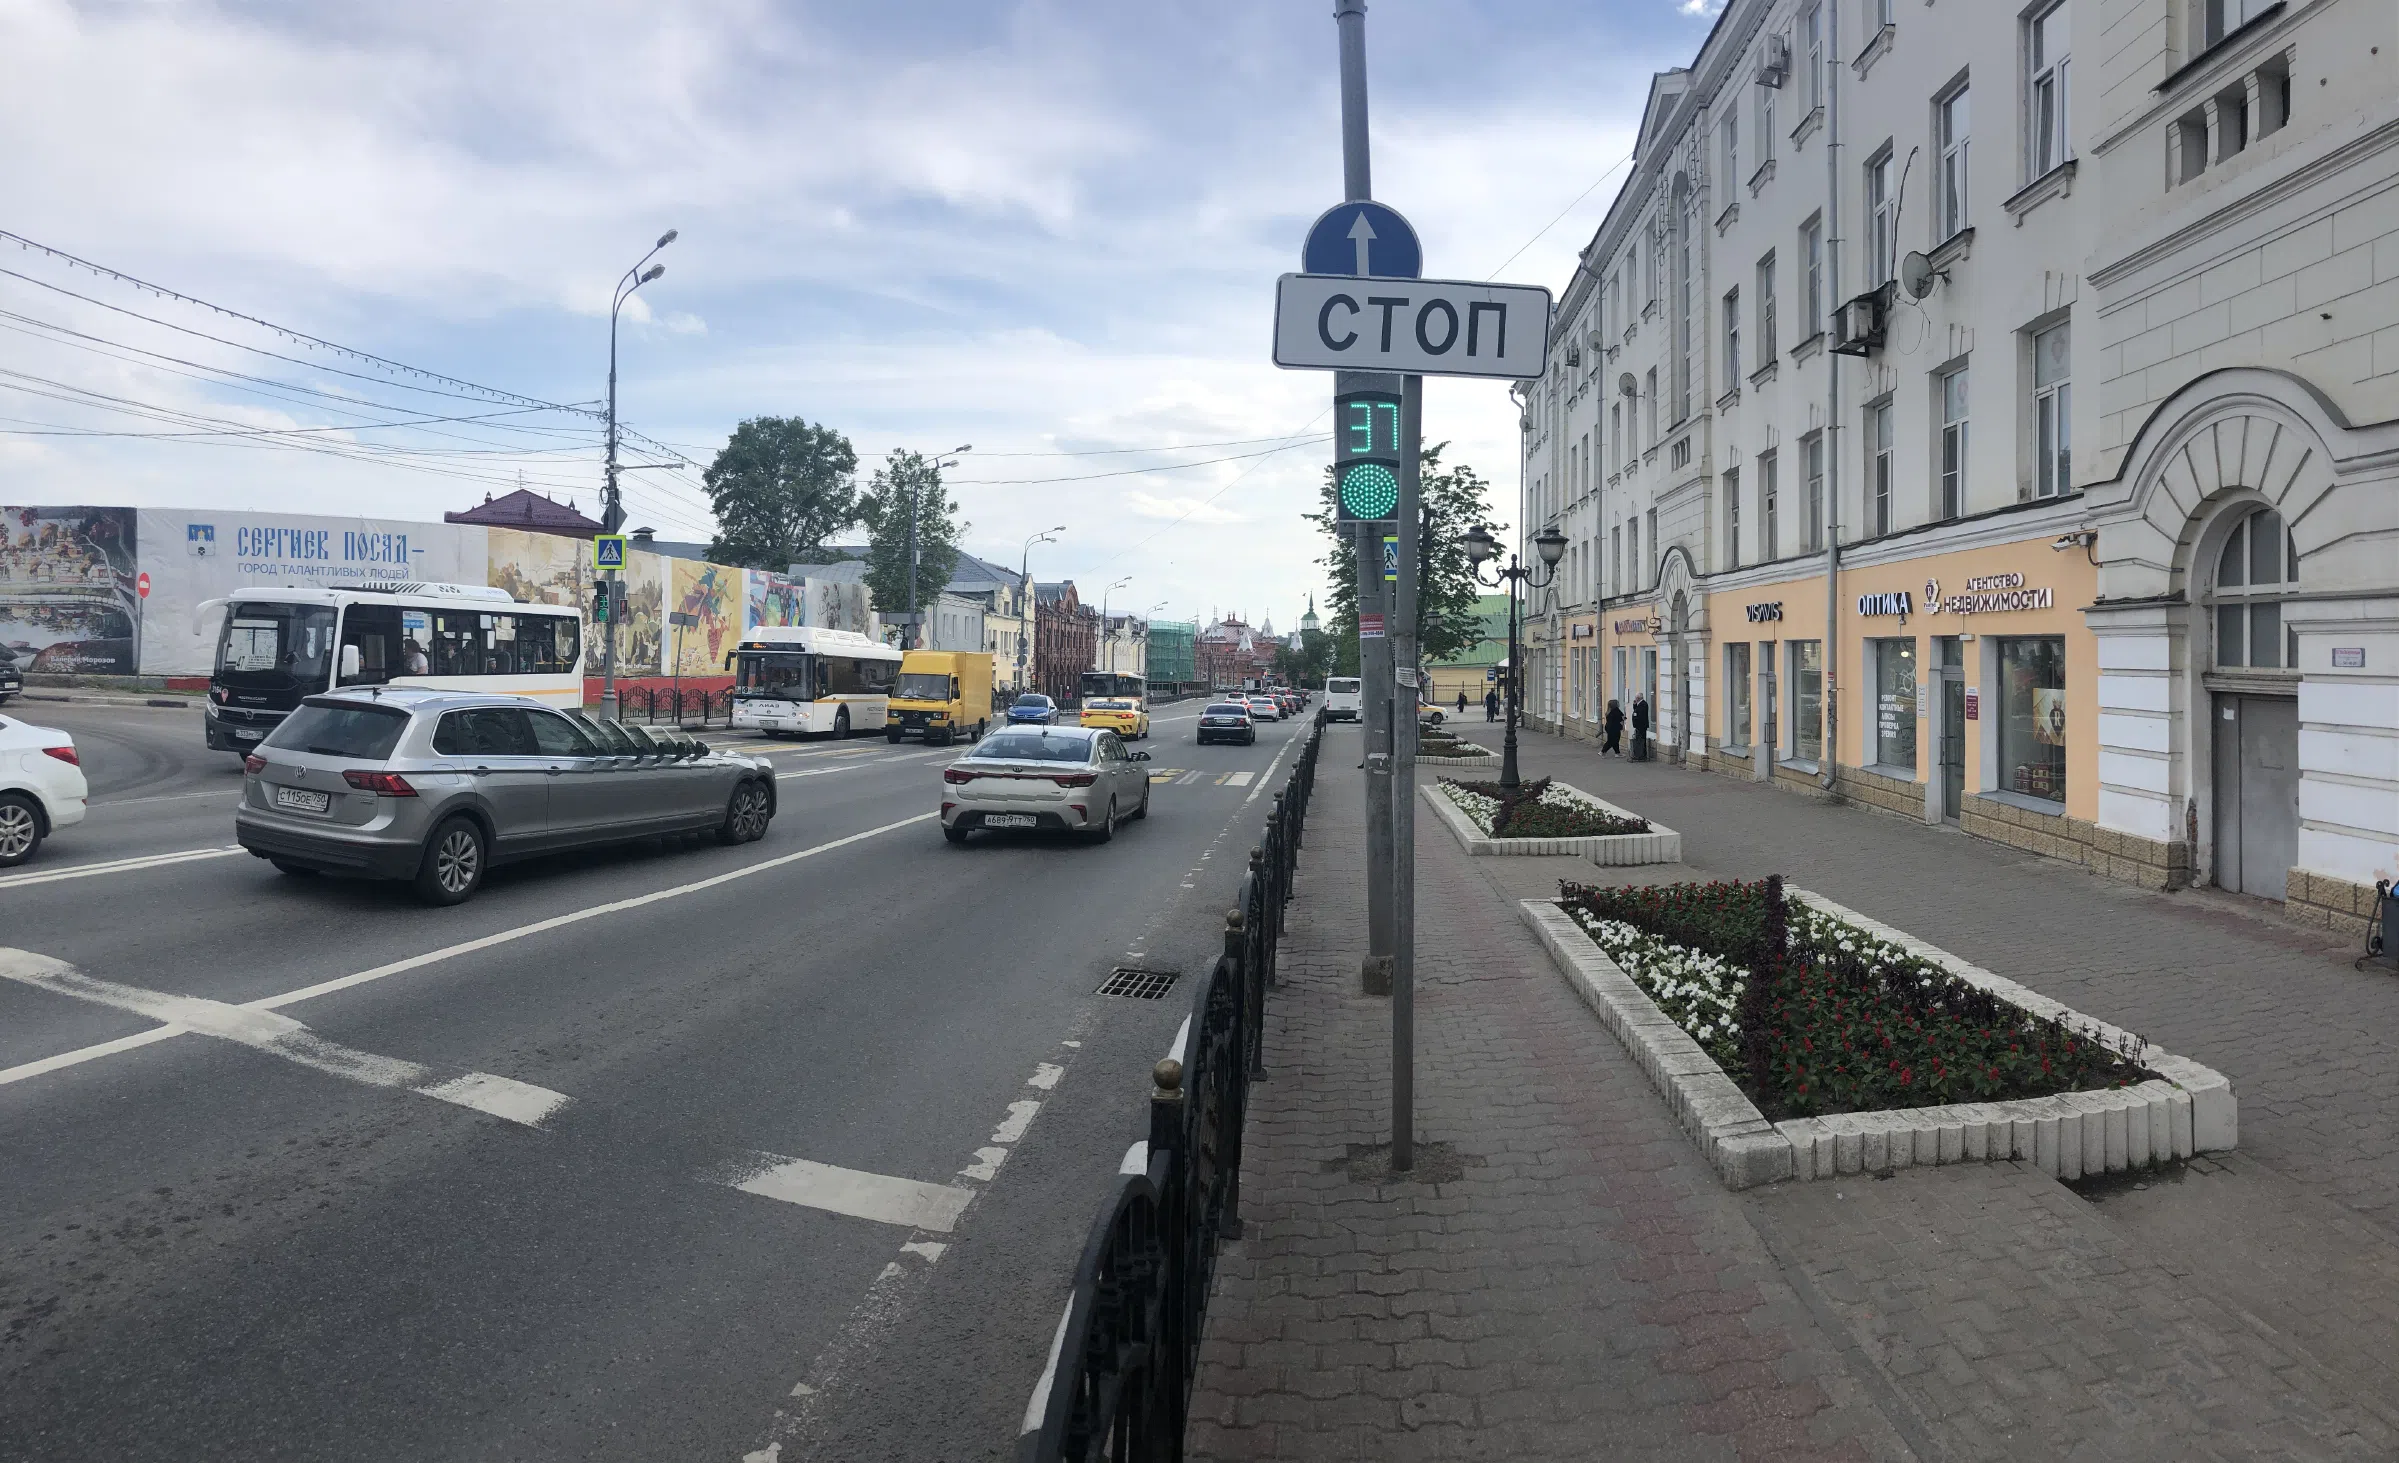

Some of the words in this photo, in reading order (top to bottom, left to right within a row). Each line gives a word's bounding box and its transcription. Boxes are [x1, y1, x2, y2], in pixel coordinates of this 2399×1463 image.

[1318, 293, 1507, 358] СТОП
[1350, 403, 1399, 453] 37
[237, 526, 329, 560] СЕРГИЕВ
[238, 562, 277, 575] ГОРОД
[281, 564, 367, 578] ТАЛАНТЛИВЫХ
[369, 567, 409, 580] ЛЮДЕЙ
[1966, 572, 2021, 591] АГЕНТСТВО
[1857, 592, 1911, 615] ОПТИКА
[1943, 588, 2050, 613] НЕДВИЖИМОСТИ
